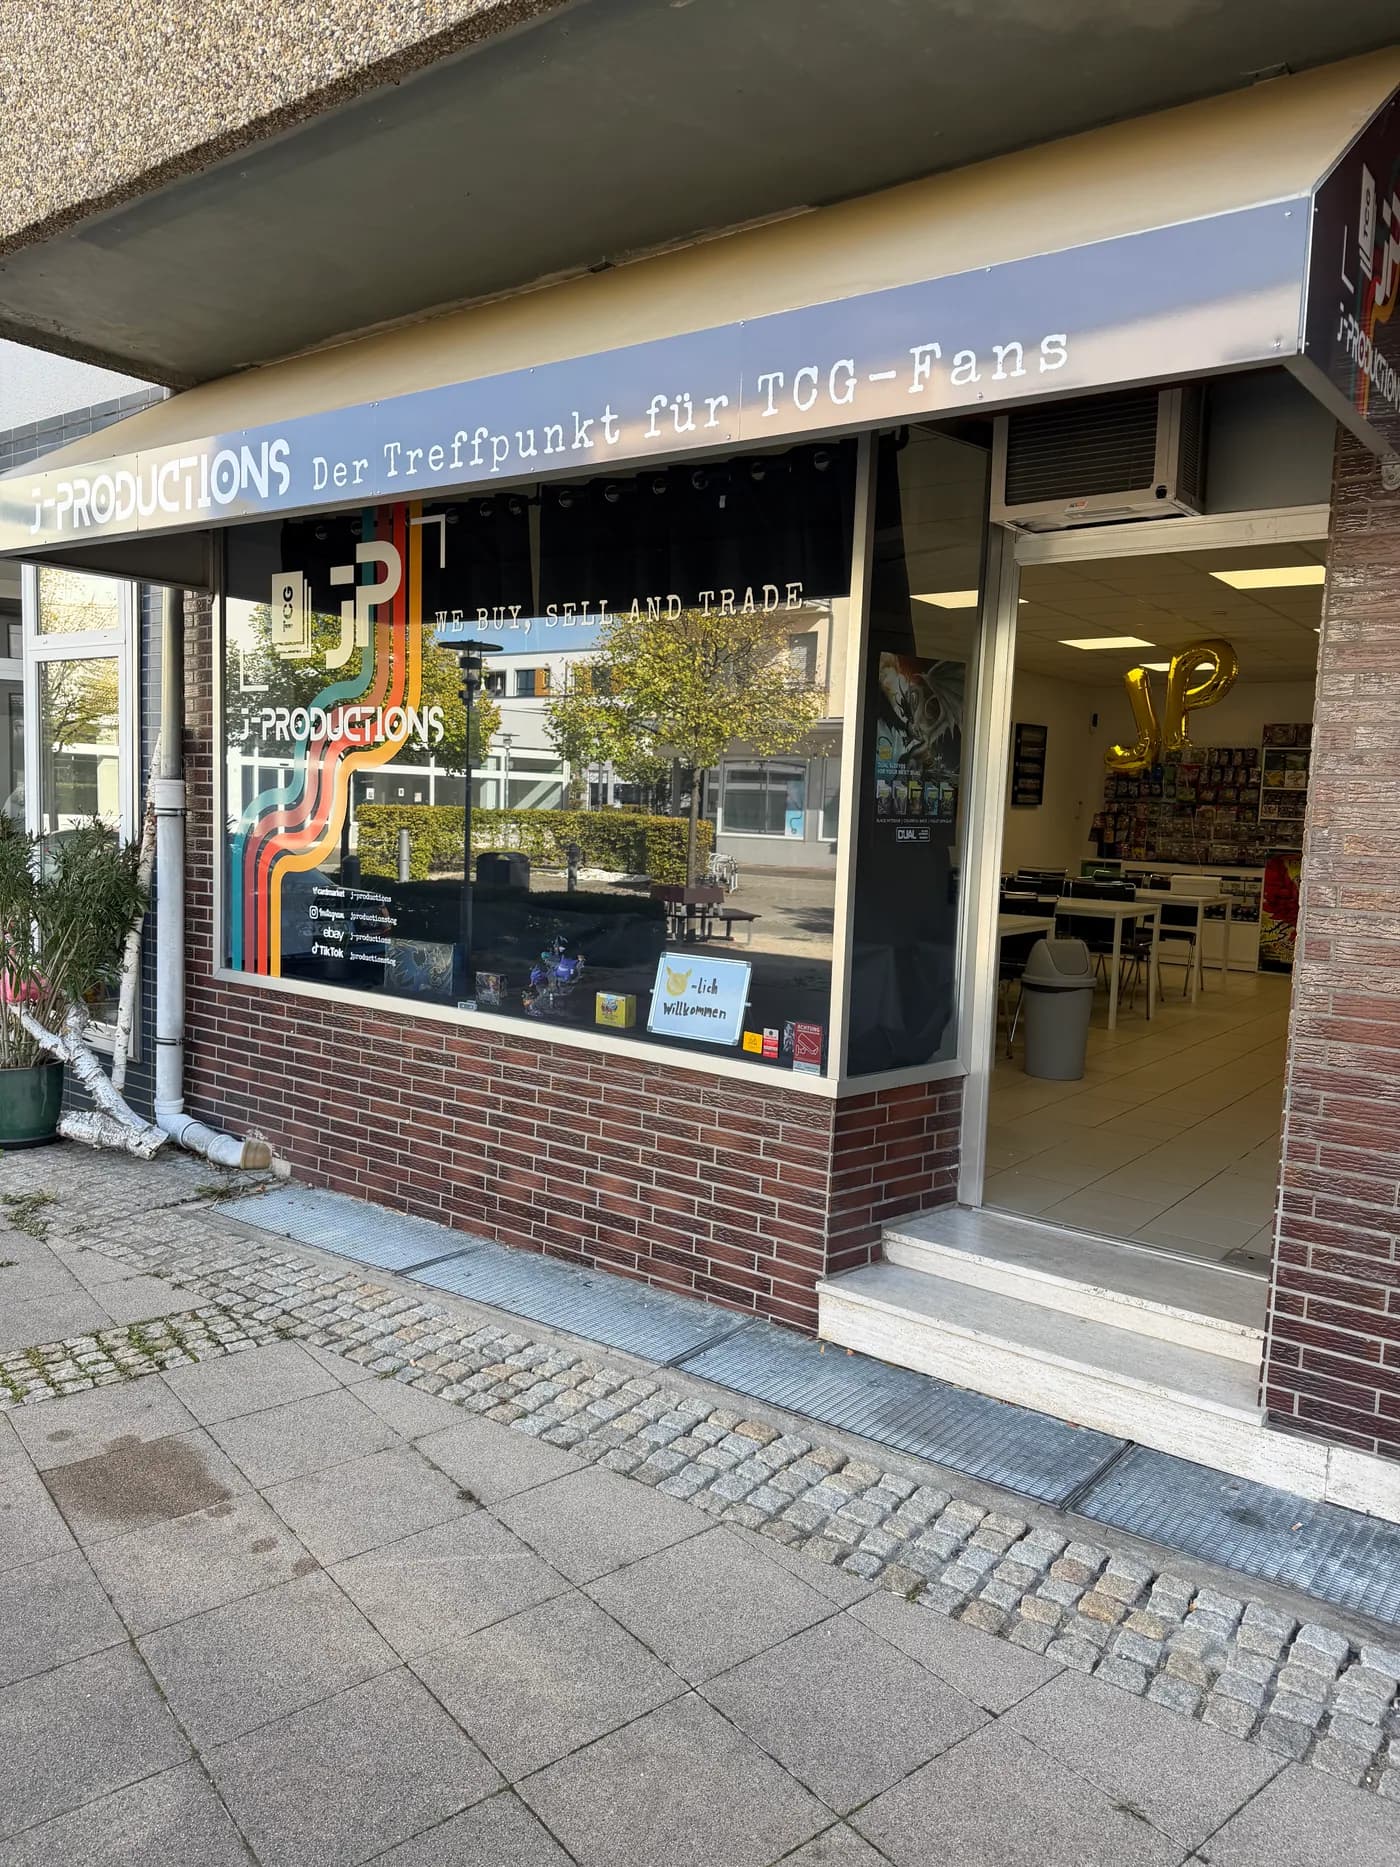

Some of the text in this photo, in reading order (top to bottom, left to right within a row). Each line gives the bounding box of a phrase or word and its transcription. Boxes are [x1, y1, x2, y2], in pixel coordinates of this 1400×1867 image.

[312, 456, 368, 491] Der
[384, 403, 620, 478] Treffpunkt
[643, 392, 729, 440] für
[757, 333, 1068, 417] TCG-Fans
[282, 585, 293, 632] TCG
[435, 582, 805, 635] WE BUY, SELL AND TRADE
[323, 926, 344, 942] ebay
[319, 944, 344, 958] TikTok
[663, 1001, 727, 1019] Willkommen
[797, 1024, 821, 1033] ACHTUNG
